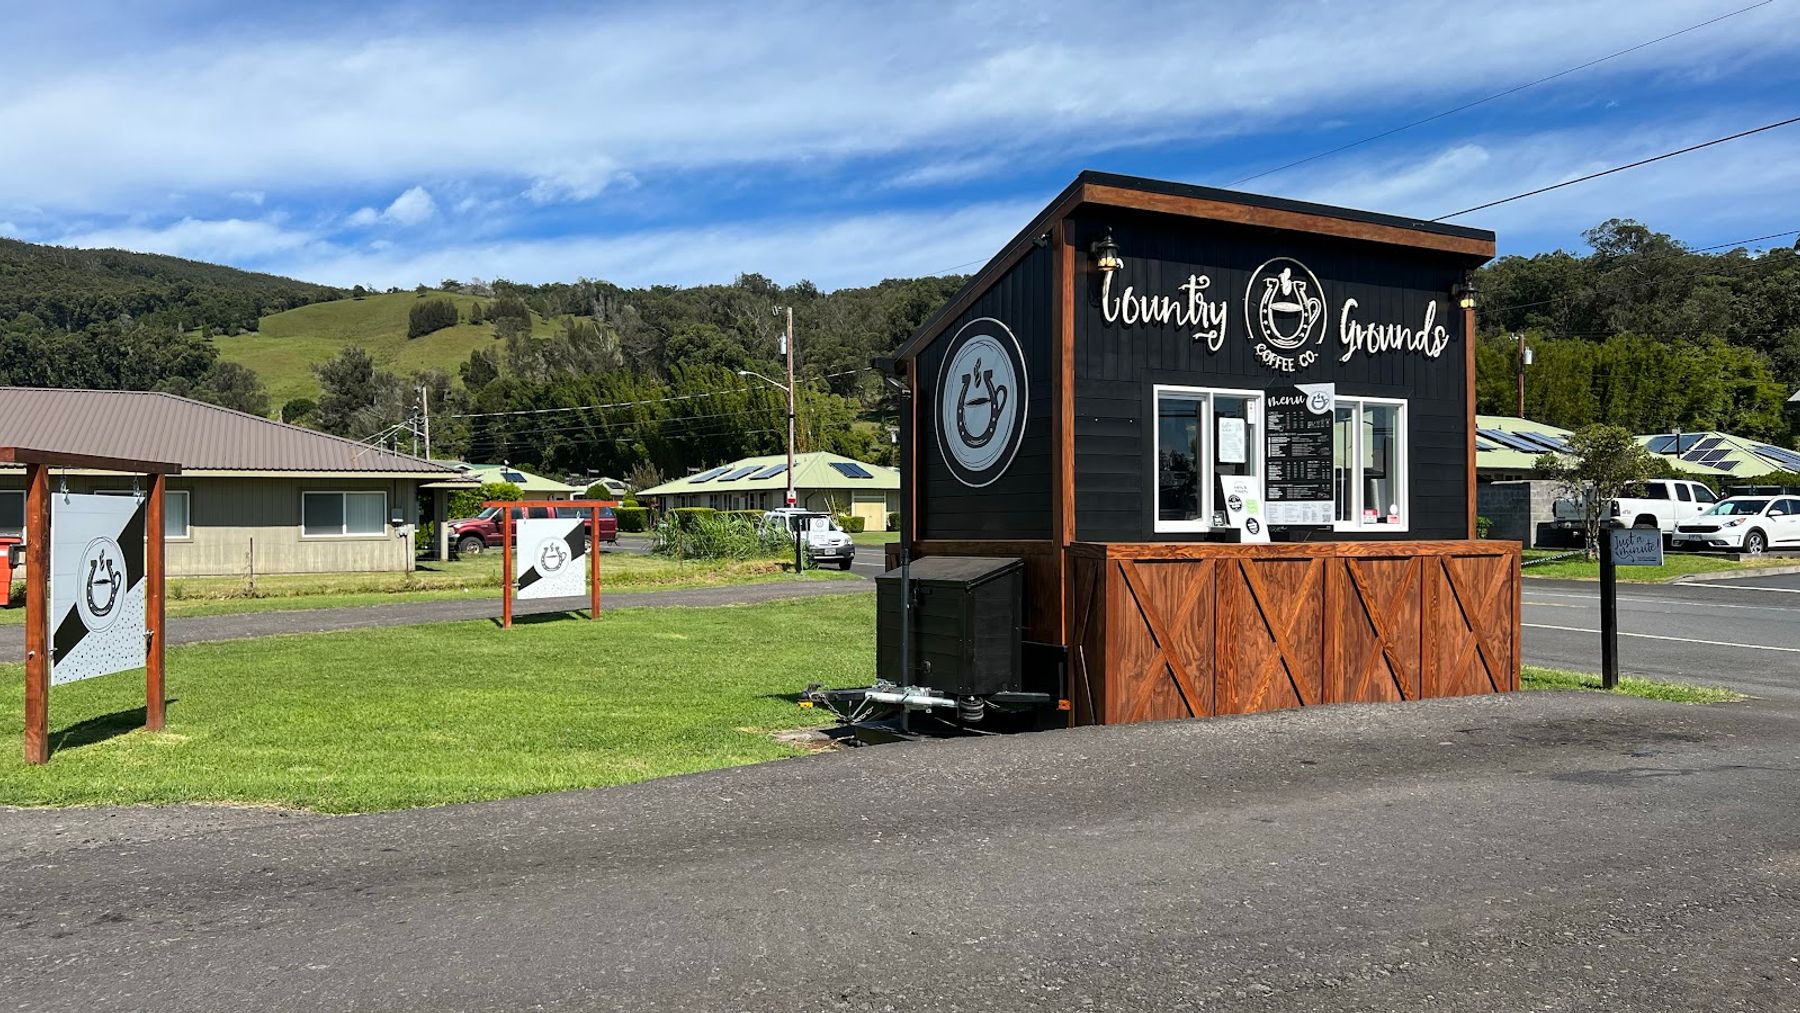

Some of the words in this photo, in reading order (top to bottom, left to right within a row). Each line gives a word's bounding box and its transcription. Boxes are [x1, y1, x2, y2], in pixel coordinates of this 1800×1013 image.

[1102, 258, 1227, 351] Country
[1339, 298, 1450, 362] Grounds
[1255, 343, 1295, 372] COFFEE
[1267, 395, 1305, 407] menu
[1614, 532, 1636, 550] Just
